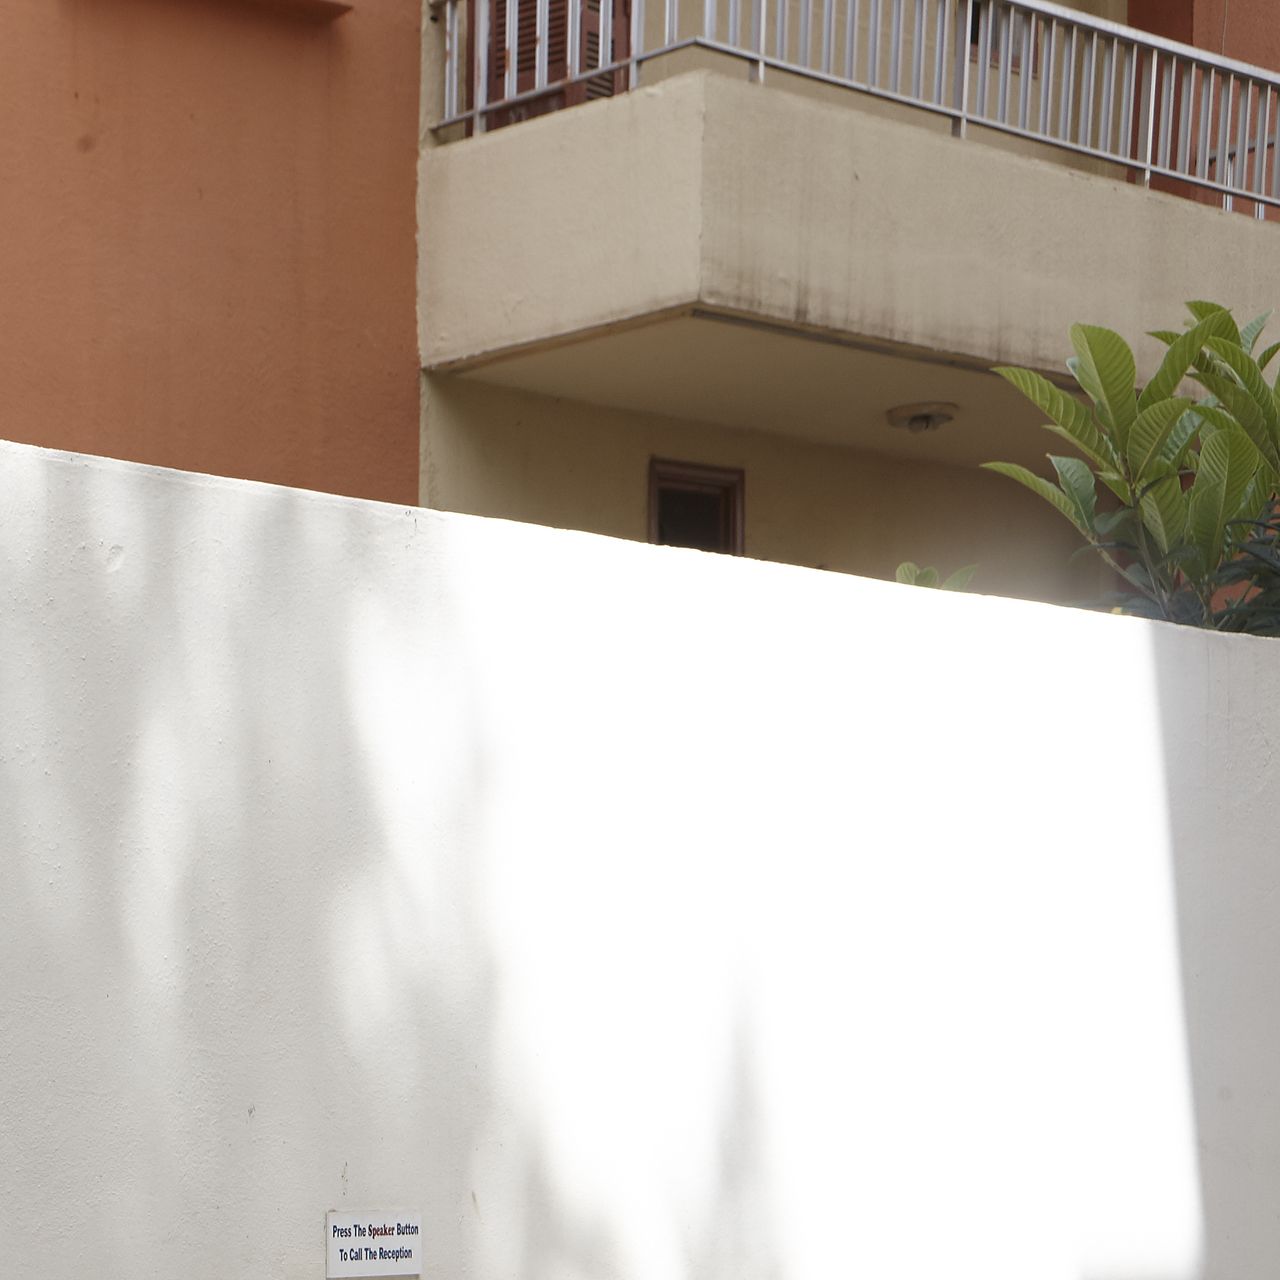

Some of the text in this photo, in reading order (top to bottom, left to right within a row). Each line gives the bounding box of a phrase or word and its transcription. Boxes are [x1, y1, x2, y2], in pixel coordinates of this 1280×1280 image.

[332, 1222, 419, 1239] Press The Speaker Button
[339, 1246, 413, 1262] To Call The Reception
